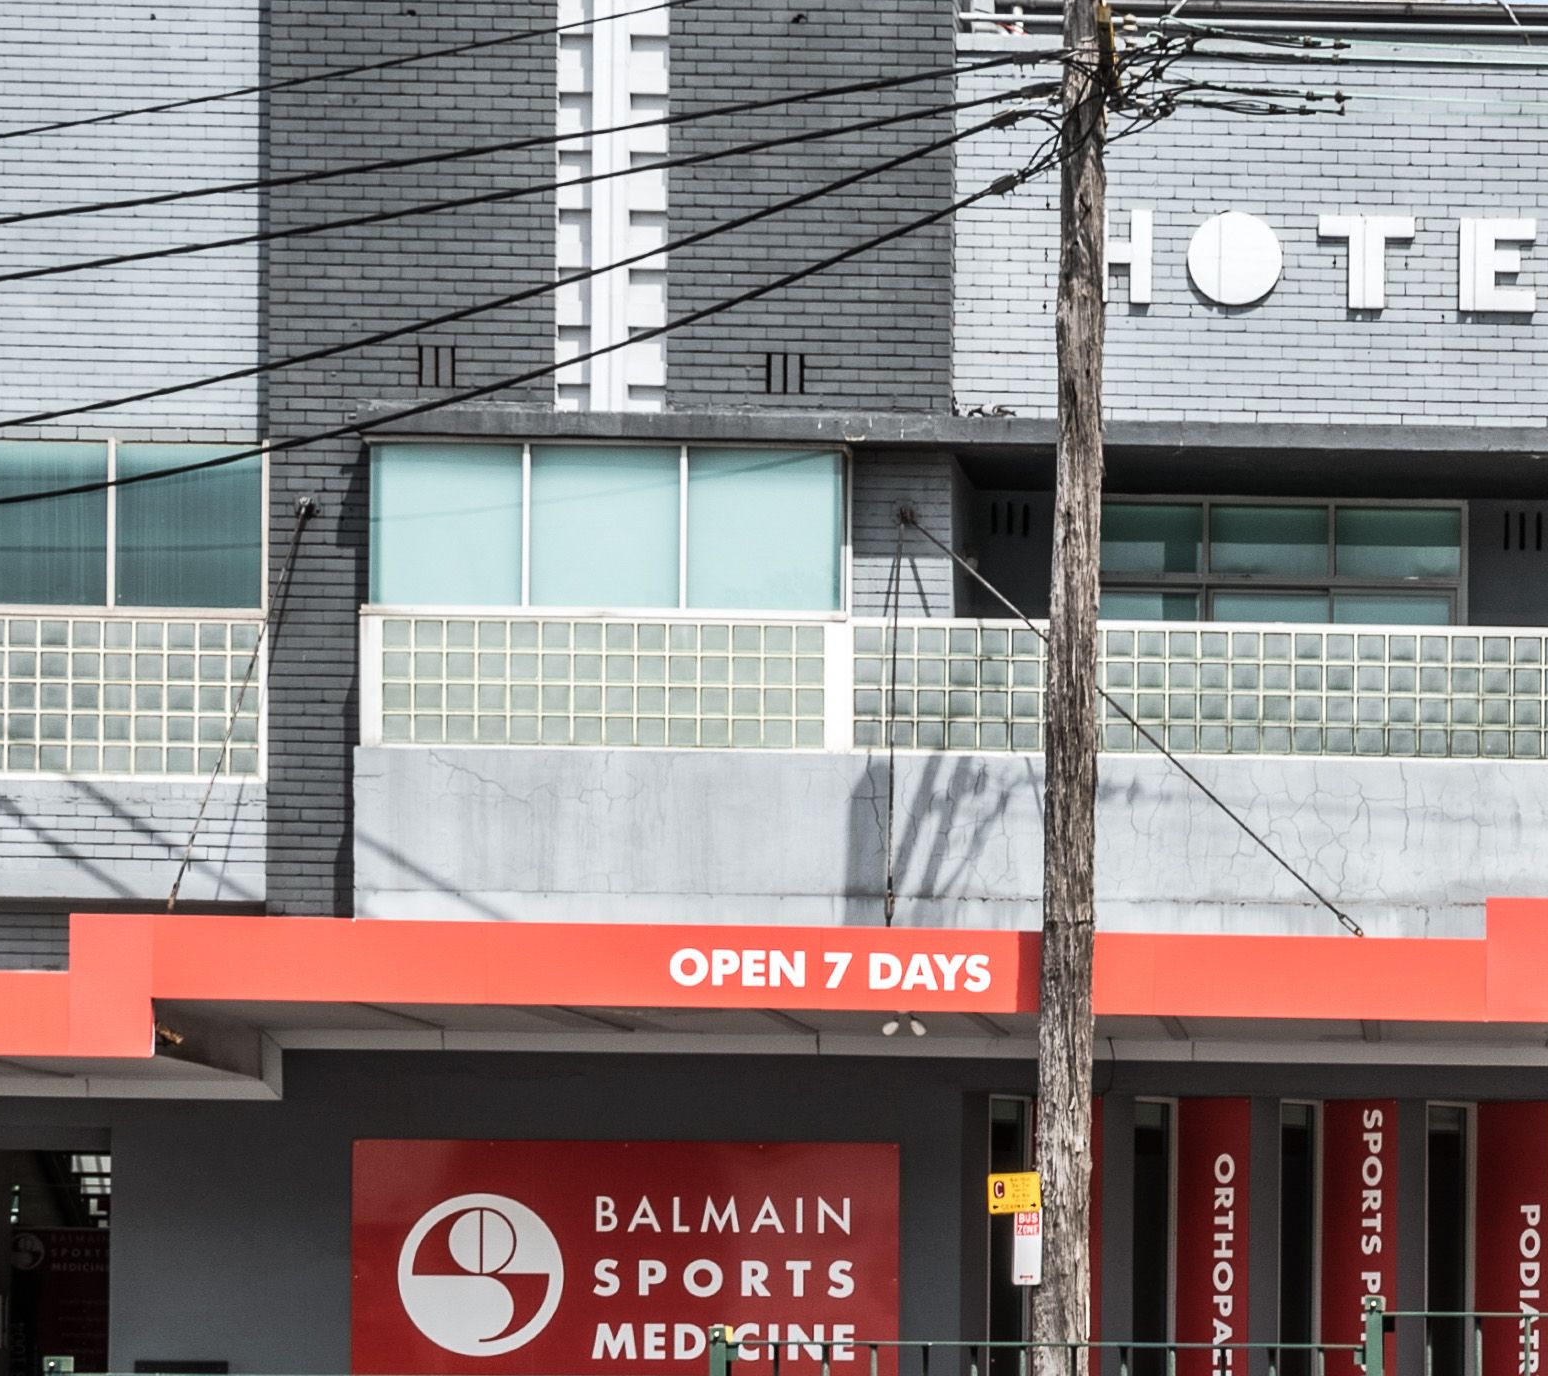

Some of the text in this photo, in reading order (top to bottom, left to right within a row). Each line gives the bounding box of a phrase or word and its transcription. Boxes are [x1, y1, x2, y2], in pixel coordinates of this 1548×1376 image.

[669, 948, 991, 992] OPEN 7 DAYS
[1361, 1109, 1383, 1256] SPORTS
[595, 1195, 851, 1236] BALMAIN
[1018, 1212, 1039, 1224] BUS
[592, 1258, 855, 1299] SPORTS
[591, 1323, 856, 1361] MEDCINE
